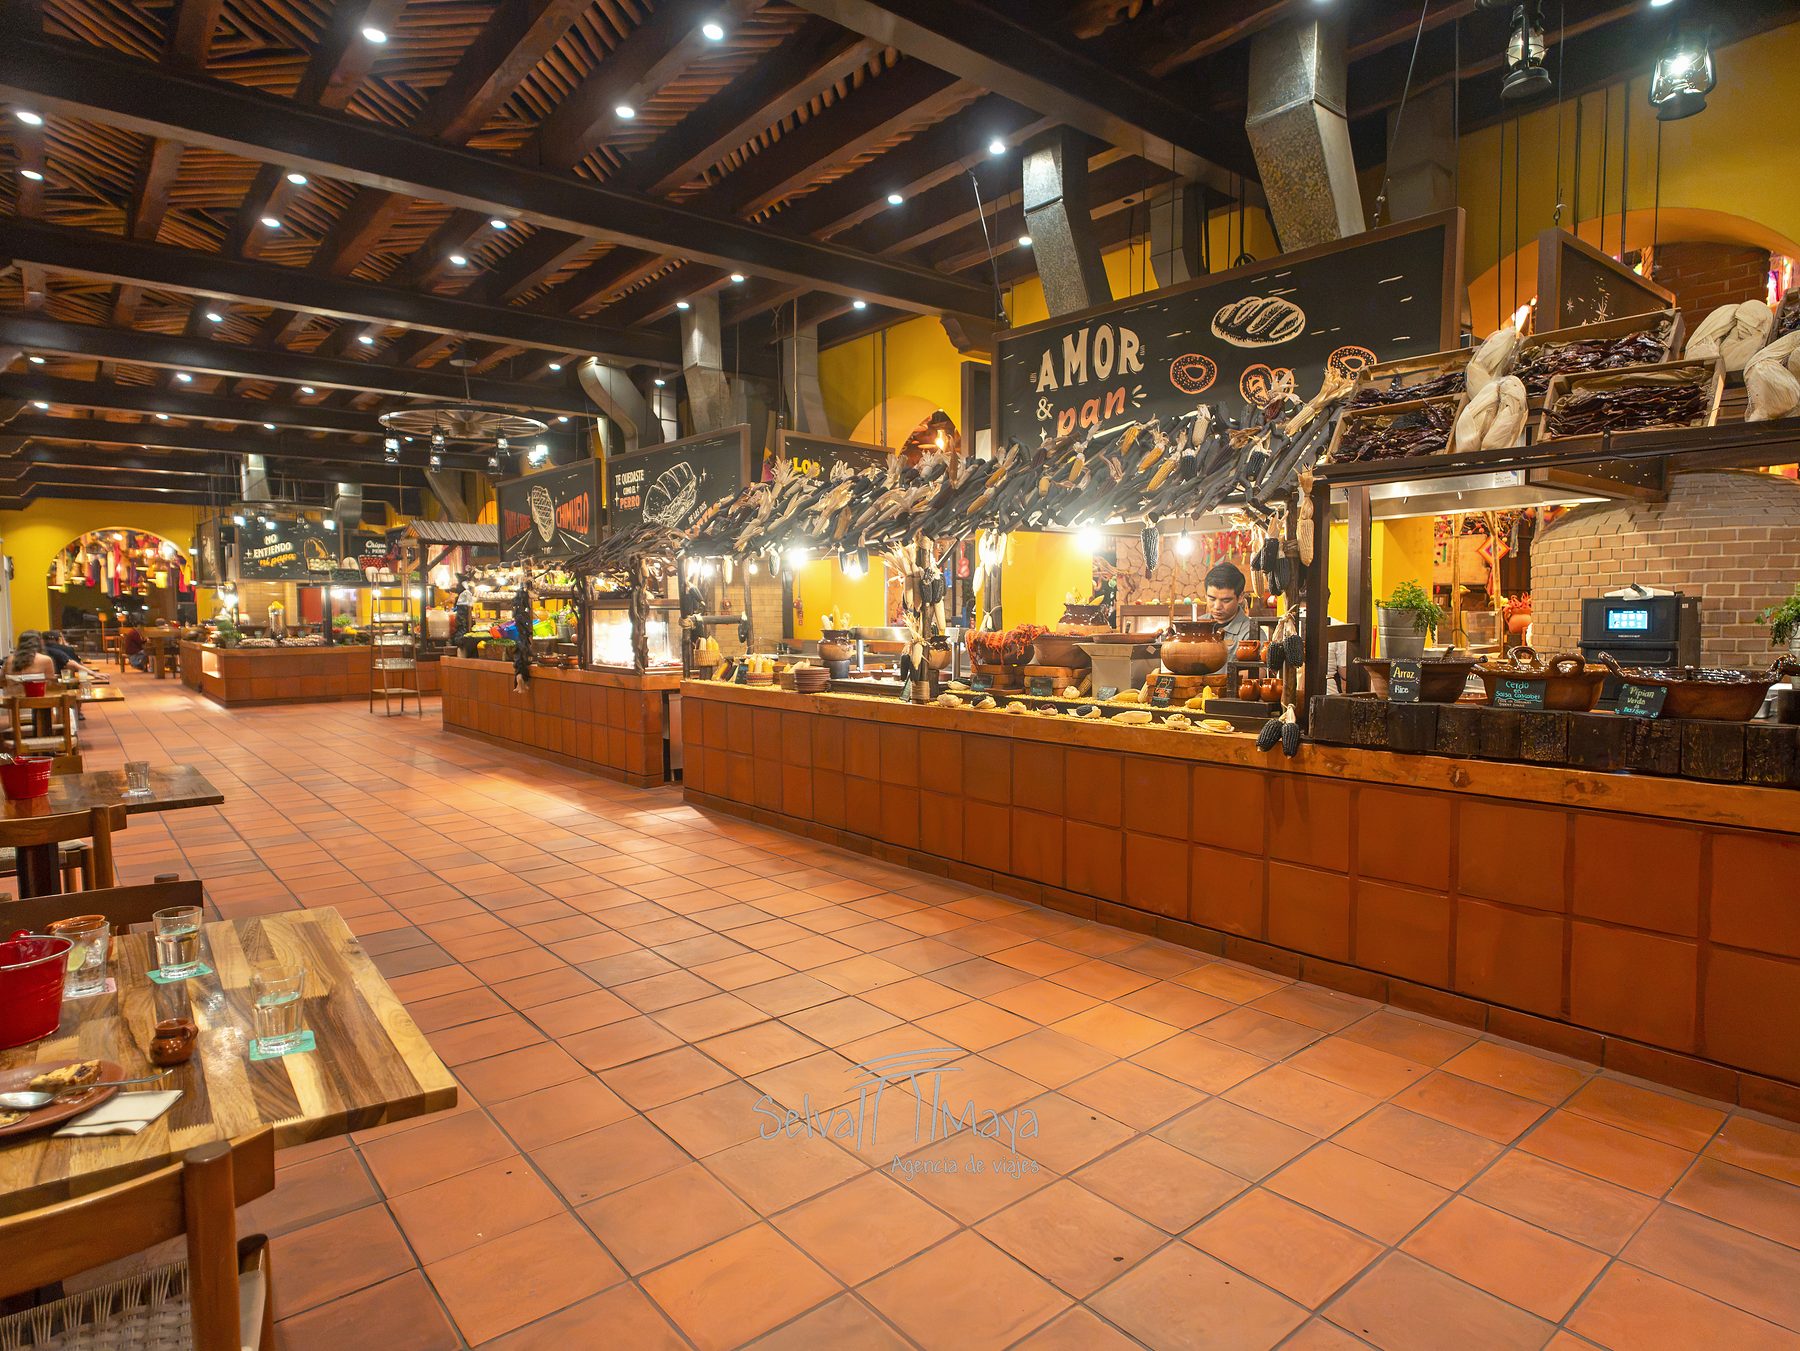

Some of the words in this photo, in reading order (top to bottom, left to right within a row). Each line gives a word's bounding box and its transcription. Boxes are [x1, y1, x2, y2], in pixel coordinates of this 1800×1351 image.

[1036, 324, 1144, 393] AMOR
[1036, 397, 1054, 421] &
[1056, 386, 1126, 439] pan
[621, 469, 645, 485] QUEDASTE
[619, 495, 640, 510] PERRO
[263, 533, 277, 546] NO
[252, 541, 293, 559] ENTIENDO
[1393, 666, 1416, 679] Arroz
[1394, 684, 1409, 694] Rice
